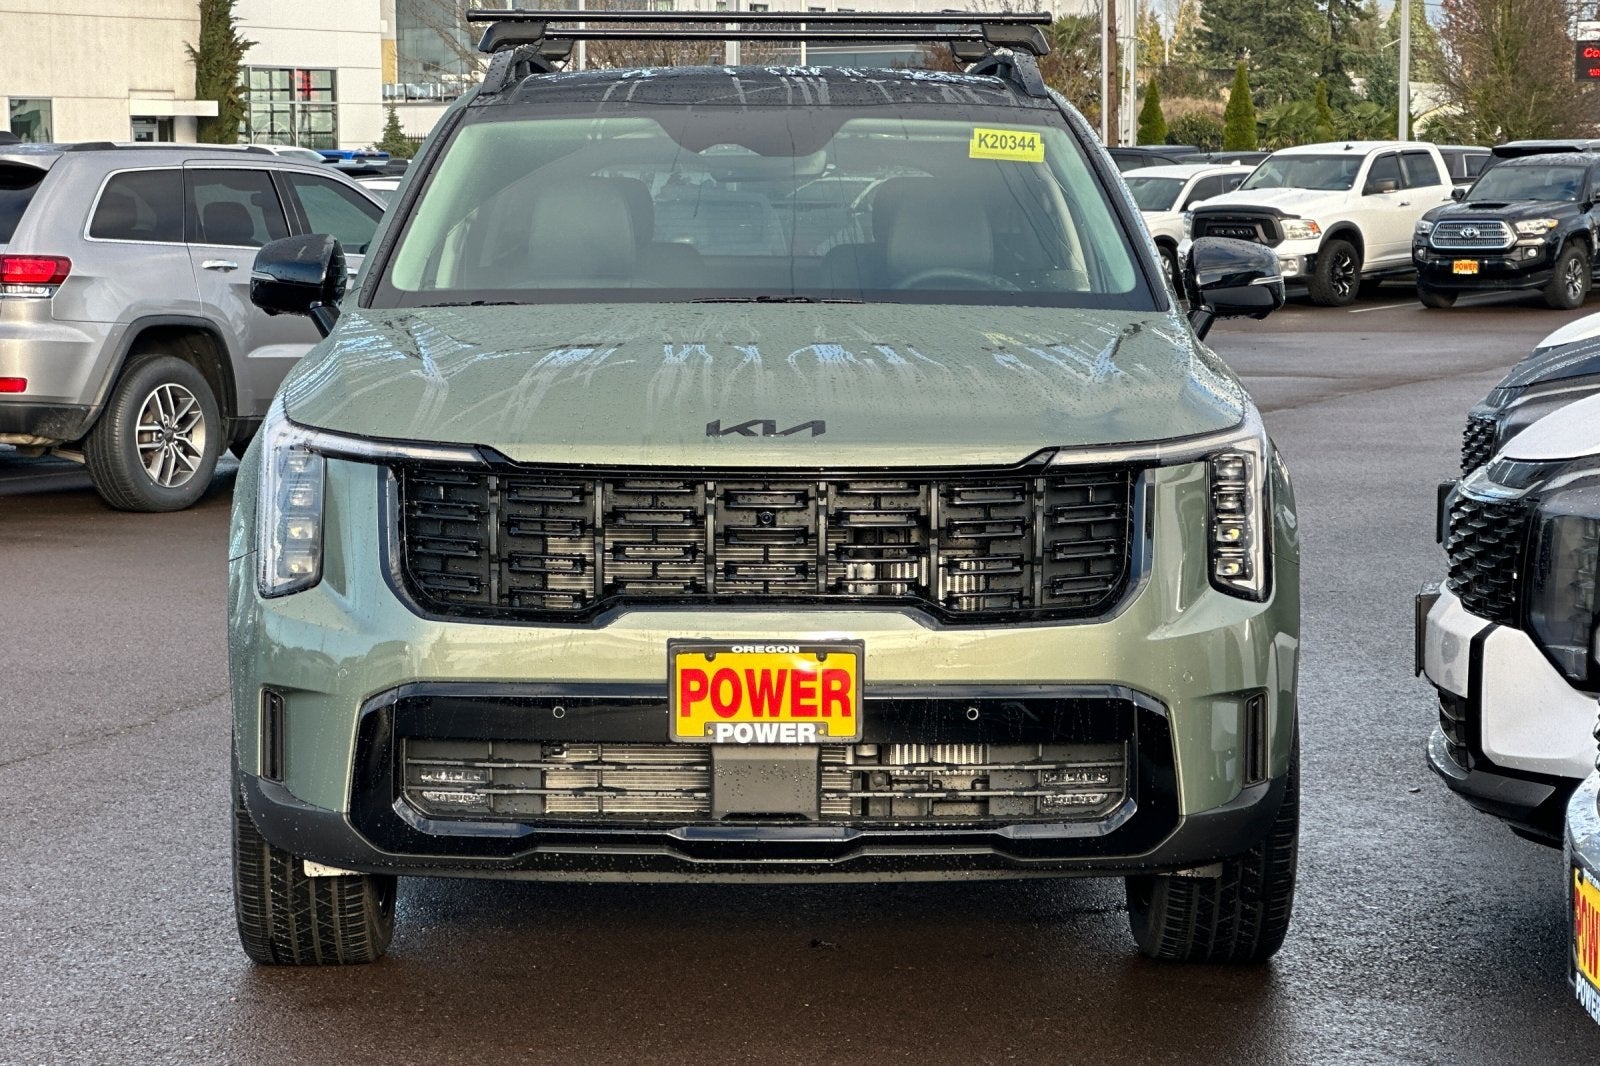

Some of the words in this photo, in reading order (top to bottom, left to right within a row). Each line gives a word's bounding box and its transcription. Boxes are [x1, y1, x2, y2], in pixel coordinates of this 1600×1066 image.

[1584, 47, 1600, 58] Co
[978, 133, 1036, 151] K20344
[731, 645, 800, 653] OREGON
[680, 667, 852, 719] POWER
[716, 722, 816, 744] POWER
